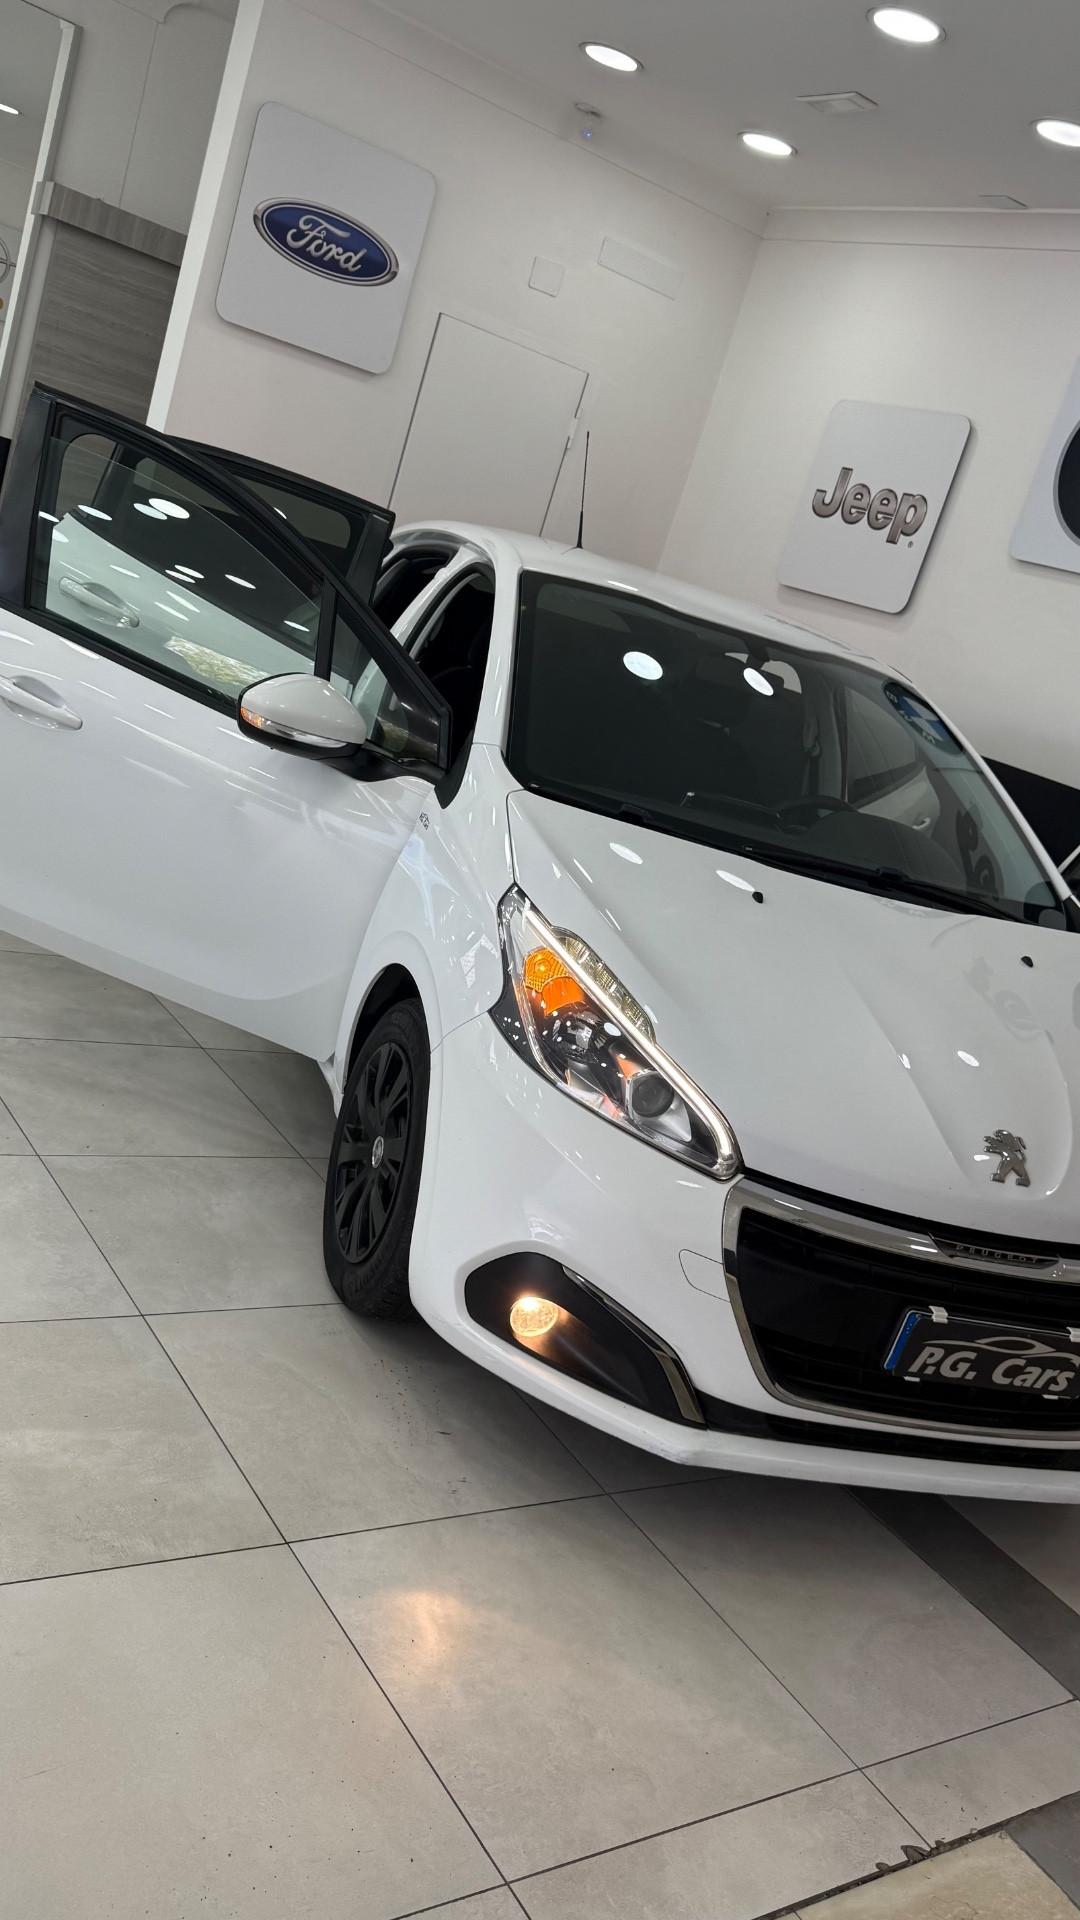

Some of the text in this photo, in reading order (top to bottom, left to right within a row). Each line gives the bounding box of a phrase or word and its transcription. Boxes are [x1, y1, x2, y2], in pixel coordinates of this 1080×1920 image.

[286, 214, 368, 272] Ford
[811, 466, 929, 545] Jeep
[955, 1243, 1039, 1264] PEUGEOT
[907, 1345, 1076, 1392] P.G. Cars
